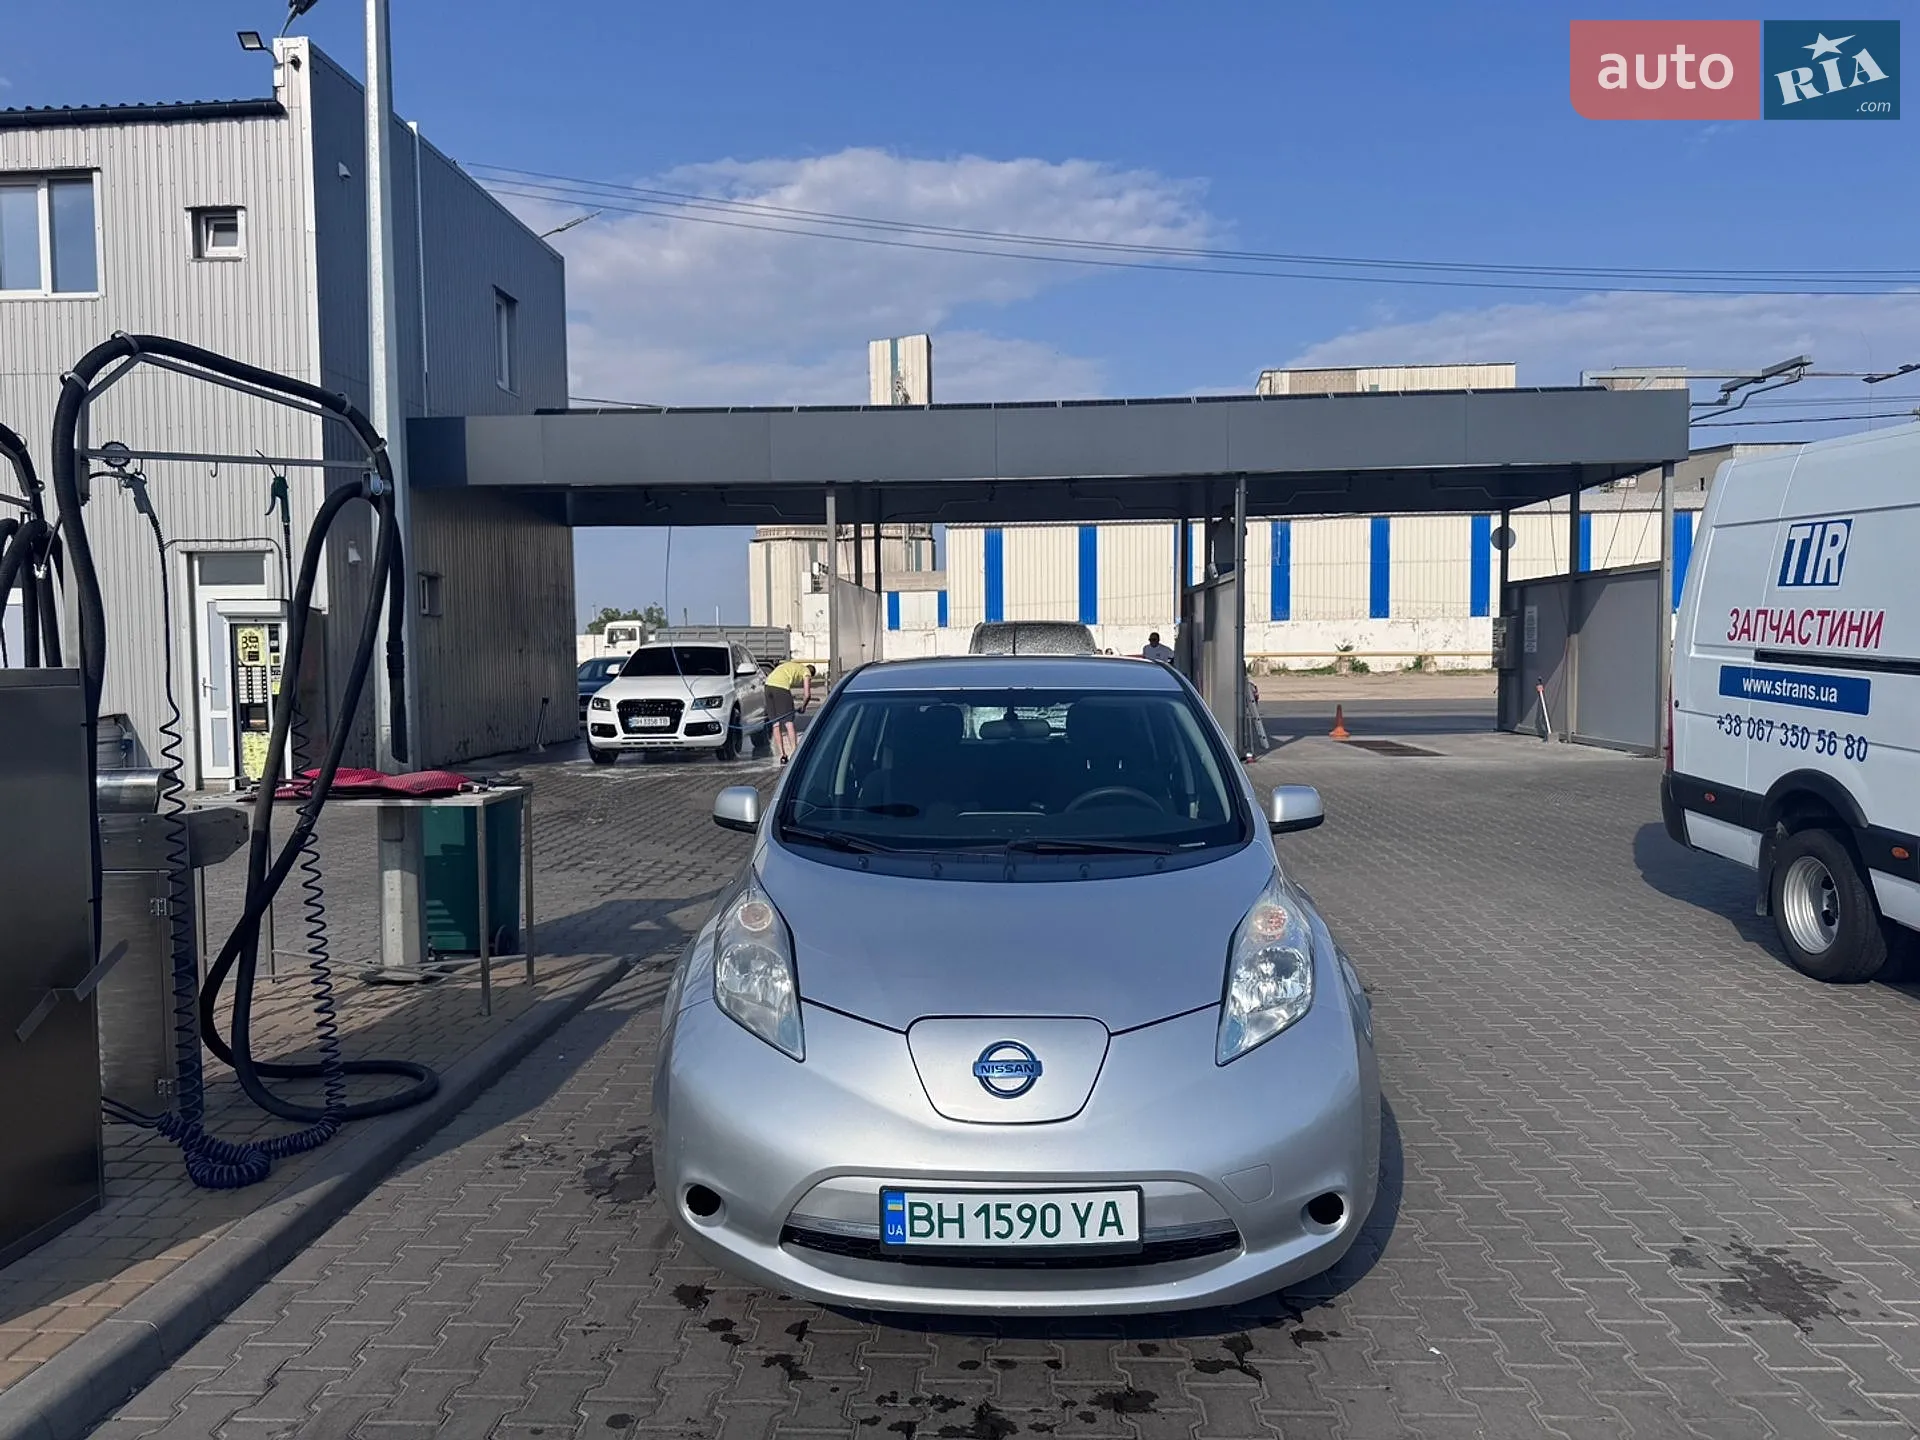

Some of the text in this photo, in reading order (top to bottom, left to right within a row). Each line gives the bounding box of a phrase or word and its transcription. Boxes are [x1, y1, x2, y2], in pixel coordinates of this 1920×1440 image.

[1785, 521, 1850, 584] TIR
[1727, 608, 1885, 649] ЗАПЧАСТИНИ
[1743, 675, 1838, 703] www.strans.ua
[1717, 713, 1868, 762] +38 067 350 56 80
[981, 1063, 1035, 1075] NISSAN
[887, 1223, 904, 1237] UA
[908, 1200, 1125, 1240] BH 1590 YA
